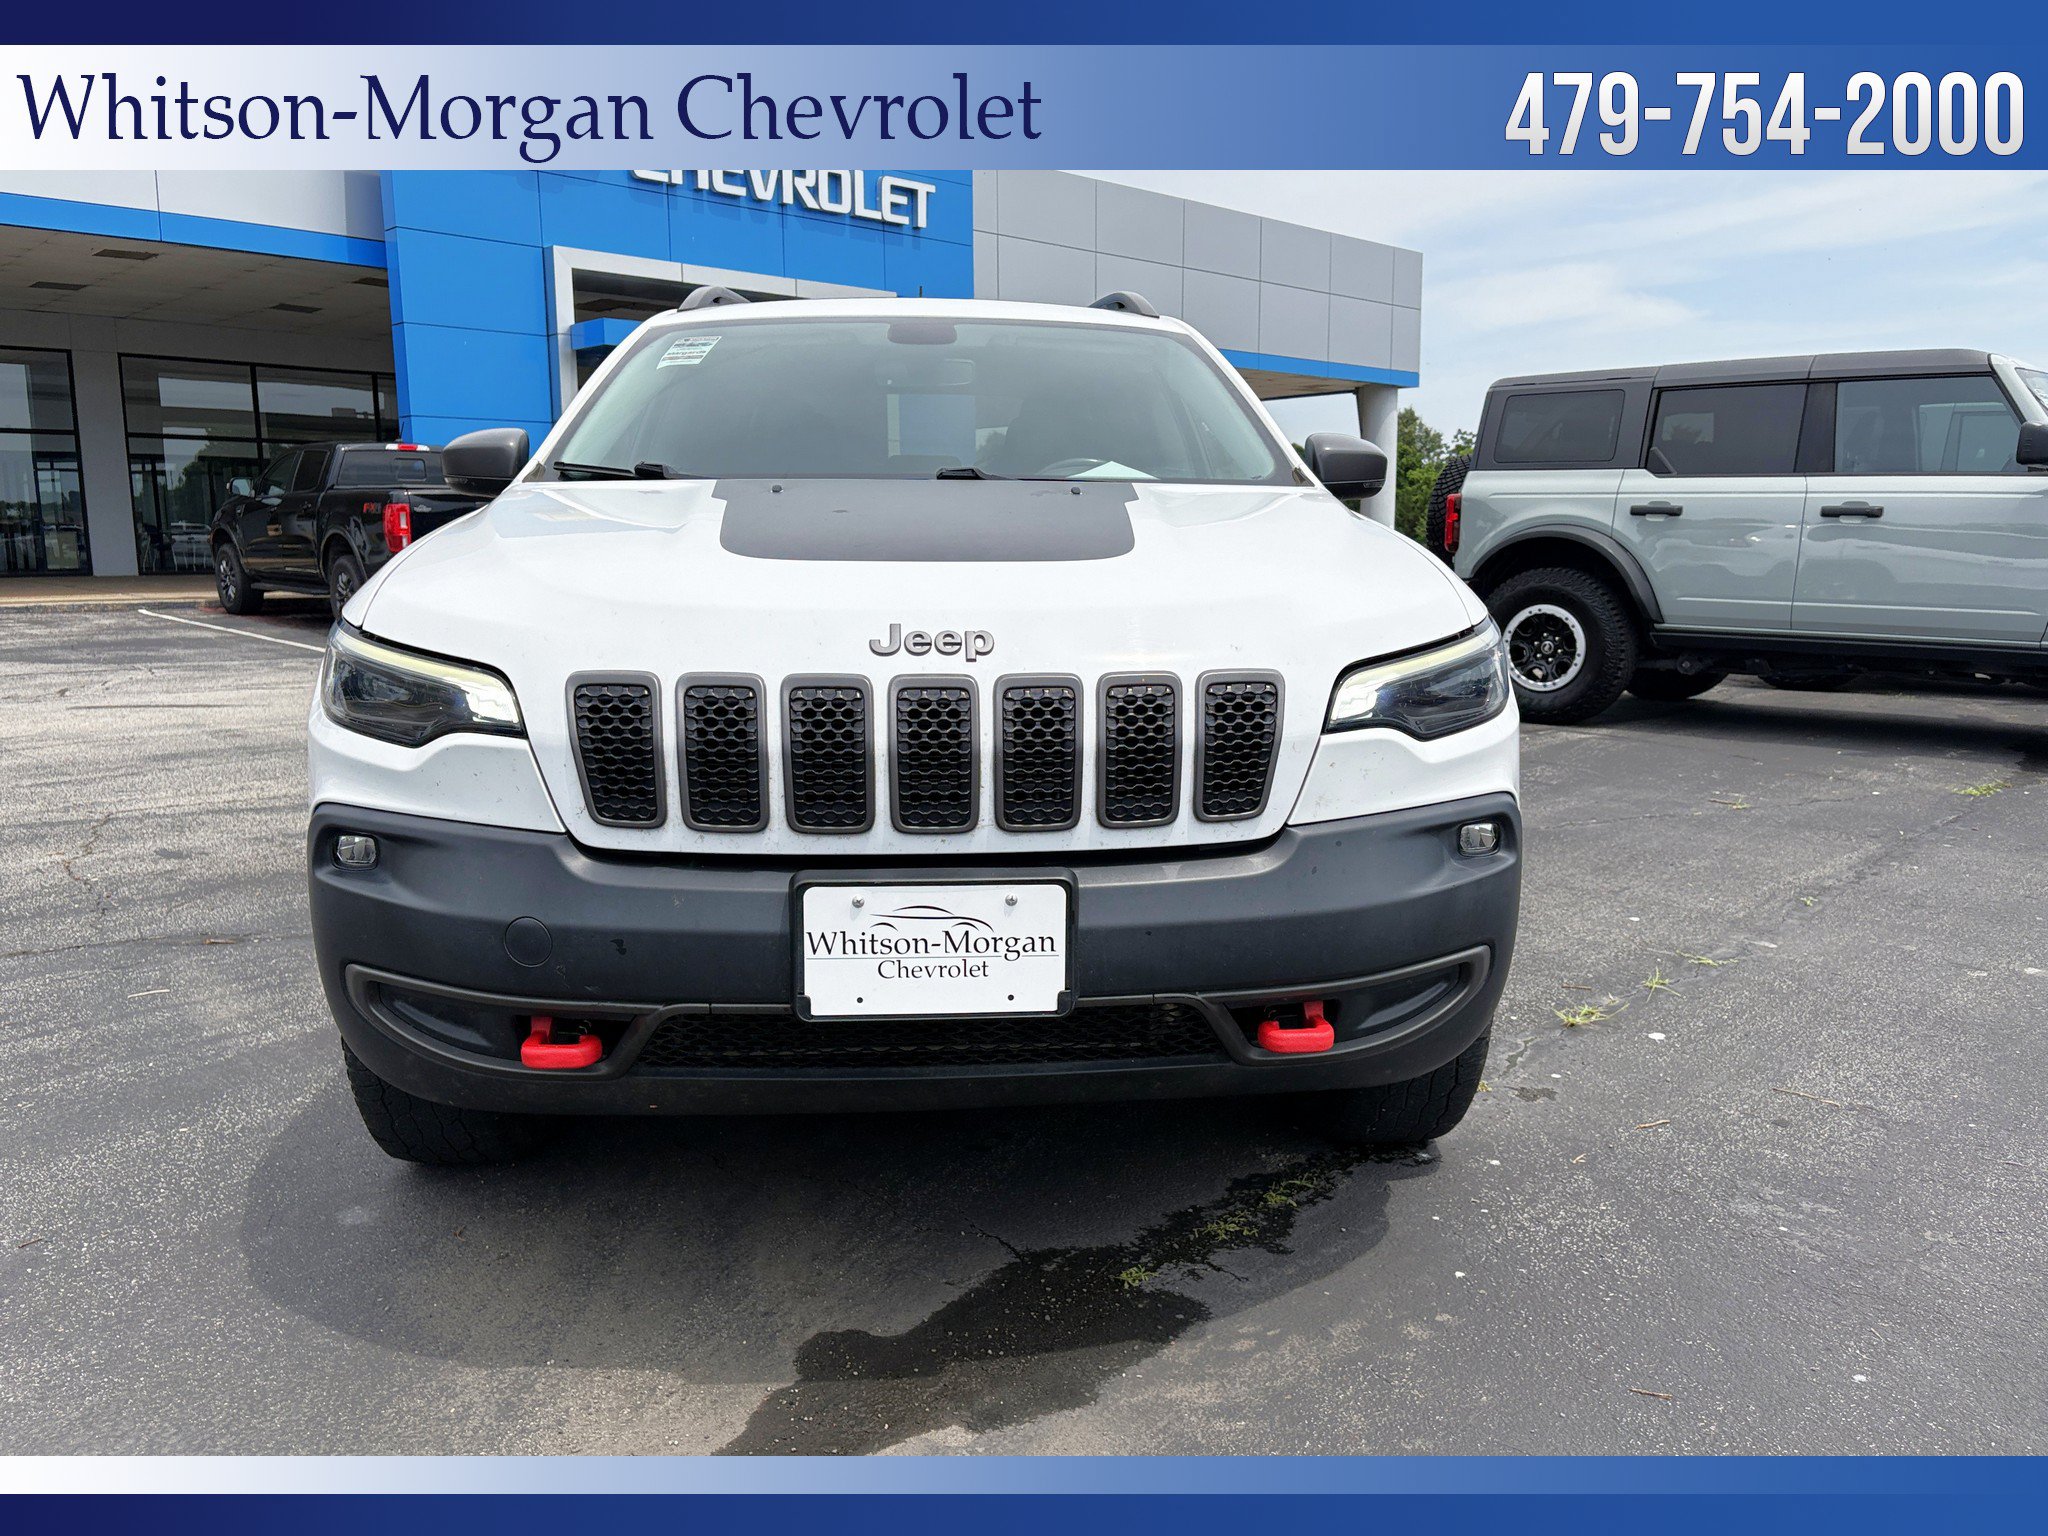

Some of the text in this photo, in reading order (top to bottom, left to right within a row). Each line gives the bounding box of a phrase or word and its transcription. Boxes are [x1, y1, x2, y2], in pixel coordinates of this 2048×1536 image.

[869, 623, 994, 662] Jeep
[805, 930, 1056, 962] Whitson-Morgan
[877, 959, 989, 979] Chevrolet
